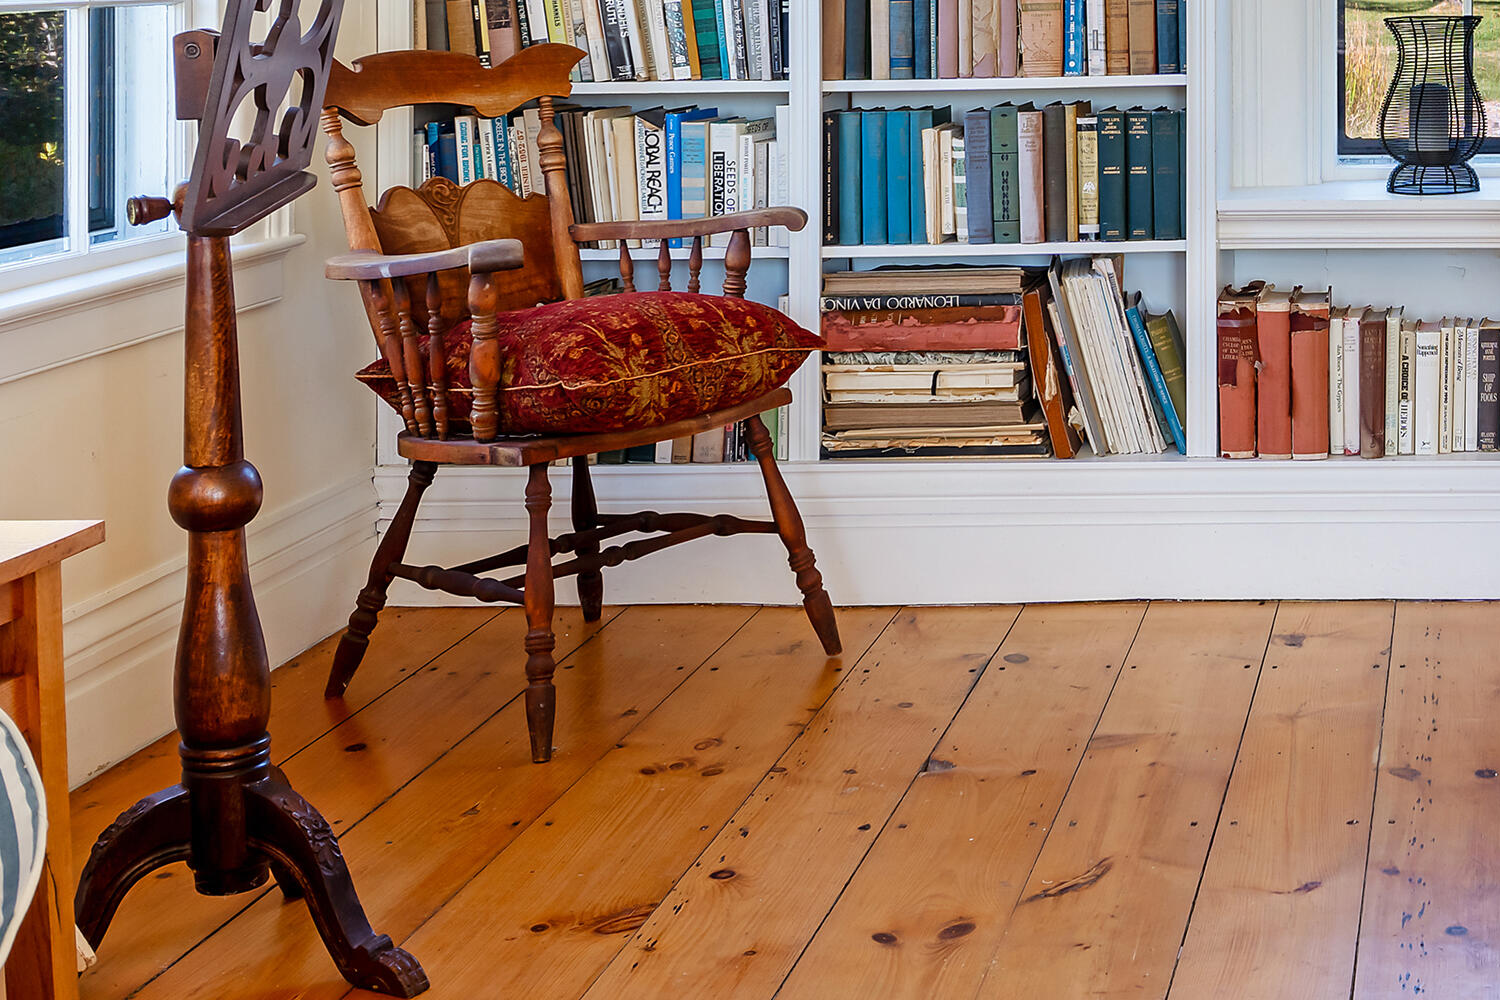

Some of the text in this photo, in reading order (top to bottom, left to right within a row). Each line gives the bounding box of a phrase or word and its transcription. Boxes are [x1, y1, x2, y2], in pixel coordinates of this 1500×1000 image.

[518, 4, 526, 20] FOR
[520, 22, 530, 46] PEACE
[754, 23, 761, 34] AS
[755, 35, 763, 72] HISTORY
[494, 117, 503, 144] GREECE
[668, 132, 676, 150] Peace
[459, 122, 470, 183] GOING FOR BROKE
[498, 153, 506, 166] THE
[669, 151, 677, 174] Games
[500, 167, 509, 187] BRON
[641, 129, 664, 215] LOBAL REACH
[713, 153, 724, 218] LIBERATION
[725, 160, 736, 213] SEEDS OF
[825, 295, 960, 311] LEONARDO DA VINC
[1336, 344, 1344, 354] Jan
[1401, 362, 1409, 390] CHOICE
[1482, 373, 1496, 382] SHIP
[1484, 383, 1493, 392] OF
[1335, 389, 1344, 413] Gypsies
[1480, 393, 1498, 402] FOOLS
[1400, 404, 1409, 438] HEROES
